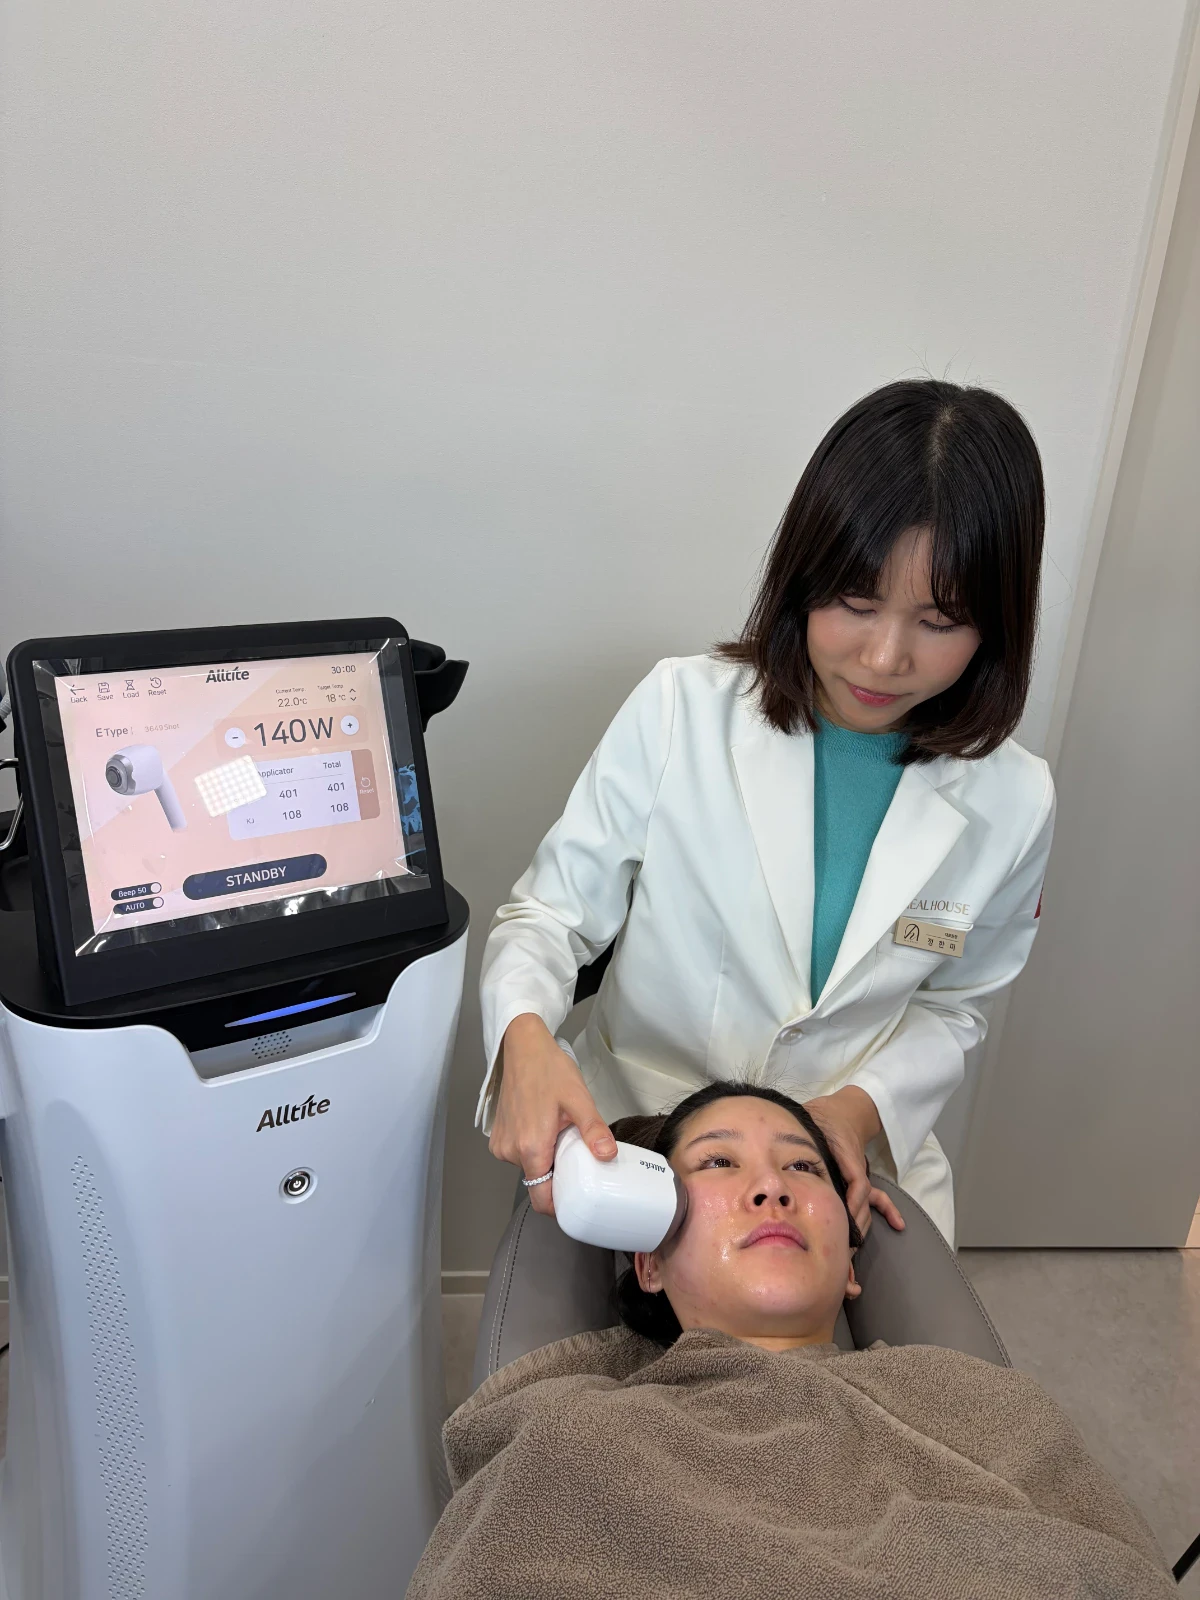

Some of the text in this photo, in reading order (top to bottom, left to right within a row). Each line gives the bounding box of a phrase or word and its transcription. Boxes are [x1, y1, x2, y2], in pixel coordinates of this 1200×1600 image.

[331, 664, 356, 674] 30:00
[322, 760, 342, 770] Total
[327, 782, 345, 792] 401
[359, 787, 375, 795] Reset
[279, 788, 298, 800] 401
[330, 802, 349, 813] 108
[283, 809, 302, 821] 108
[226, 865, 287, 888] STANDBY
[118, 886, 147, 898] Beep 50
[125, 901, 145, 911] AUTO
